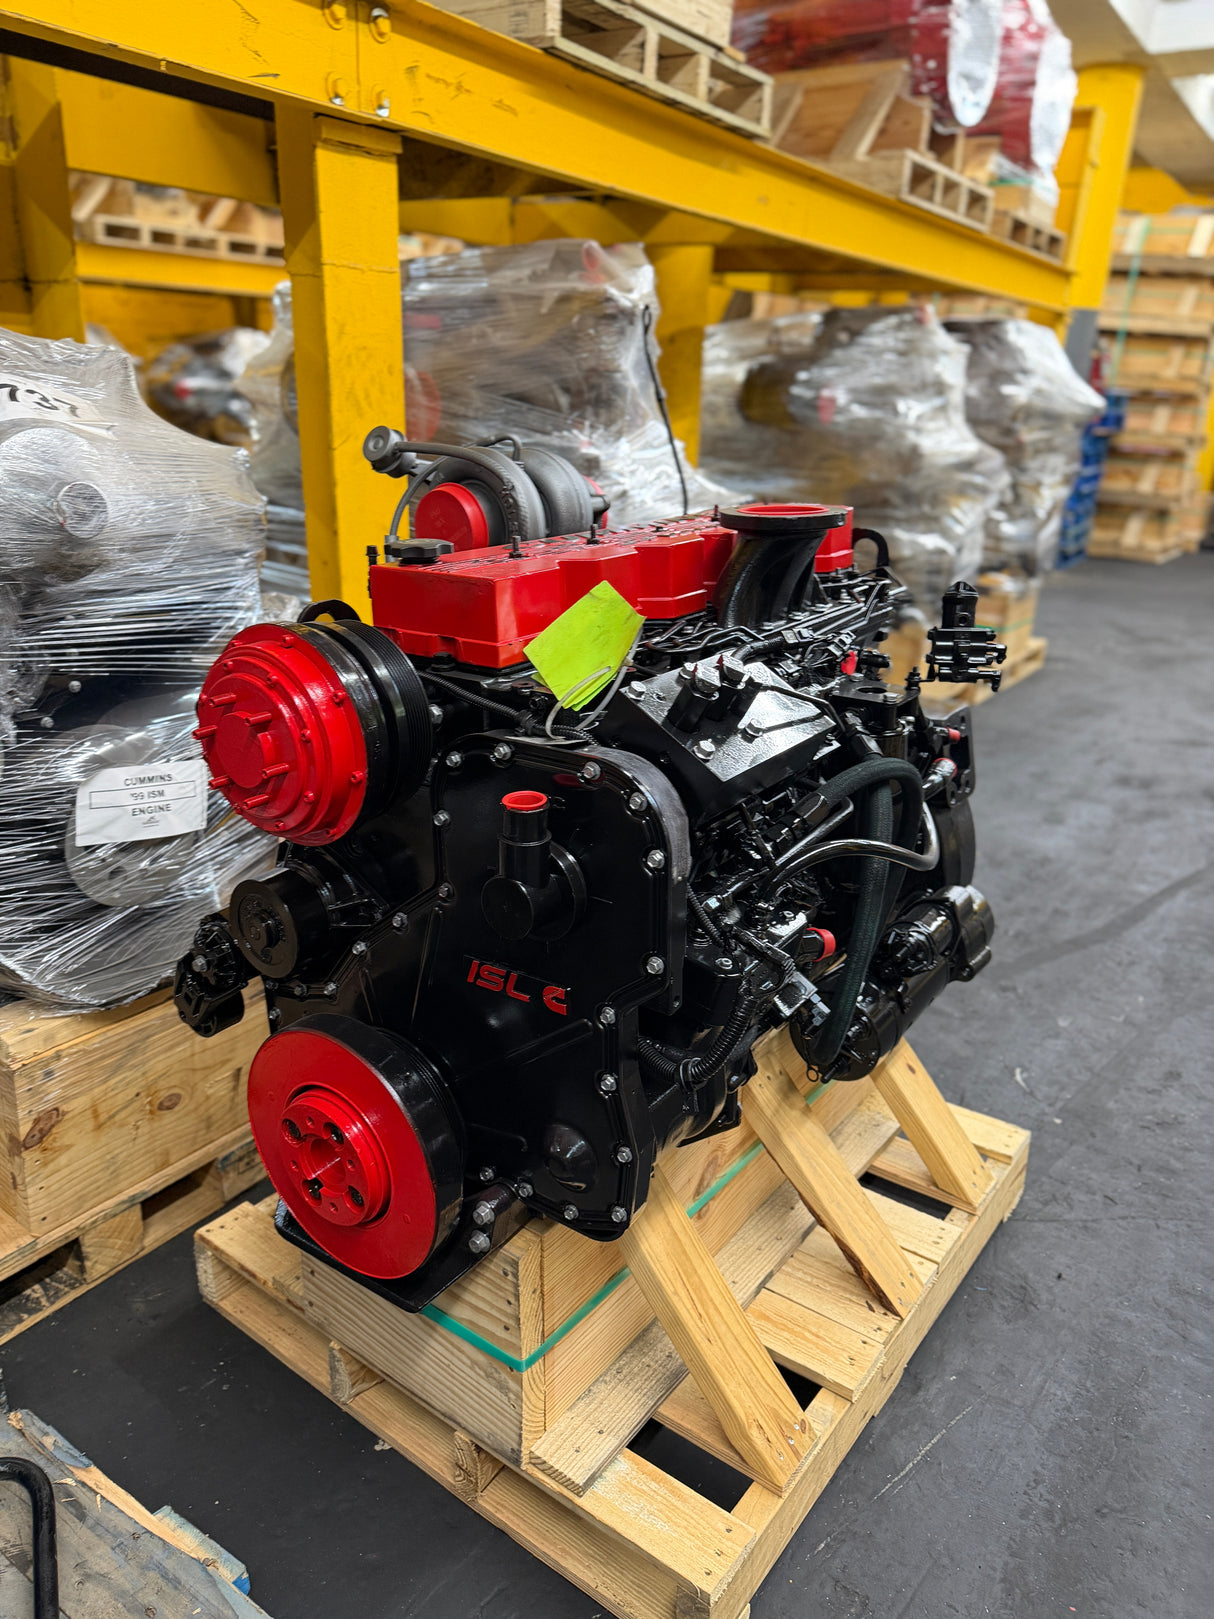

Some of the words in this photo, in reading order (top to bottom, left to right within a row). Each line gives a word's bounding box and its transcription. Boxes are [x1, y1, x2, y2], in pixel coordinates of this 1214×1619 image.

[124, 773, 173, 787] CUMMINS
[147, 789, 165, 799] ISM
[131, 803, 172, 817] ENGINE
[467, 960, 530, 1002] ISL
